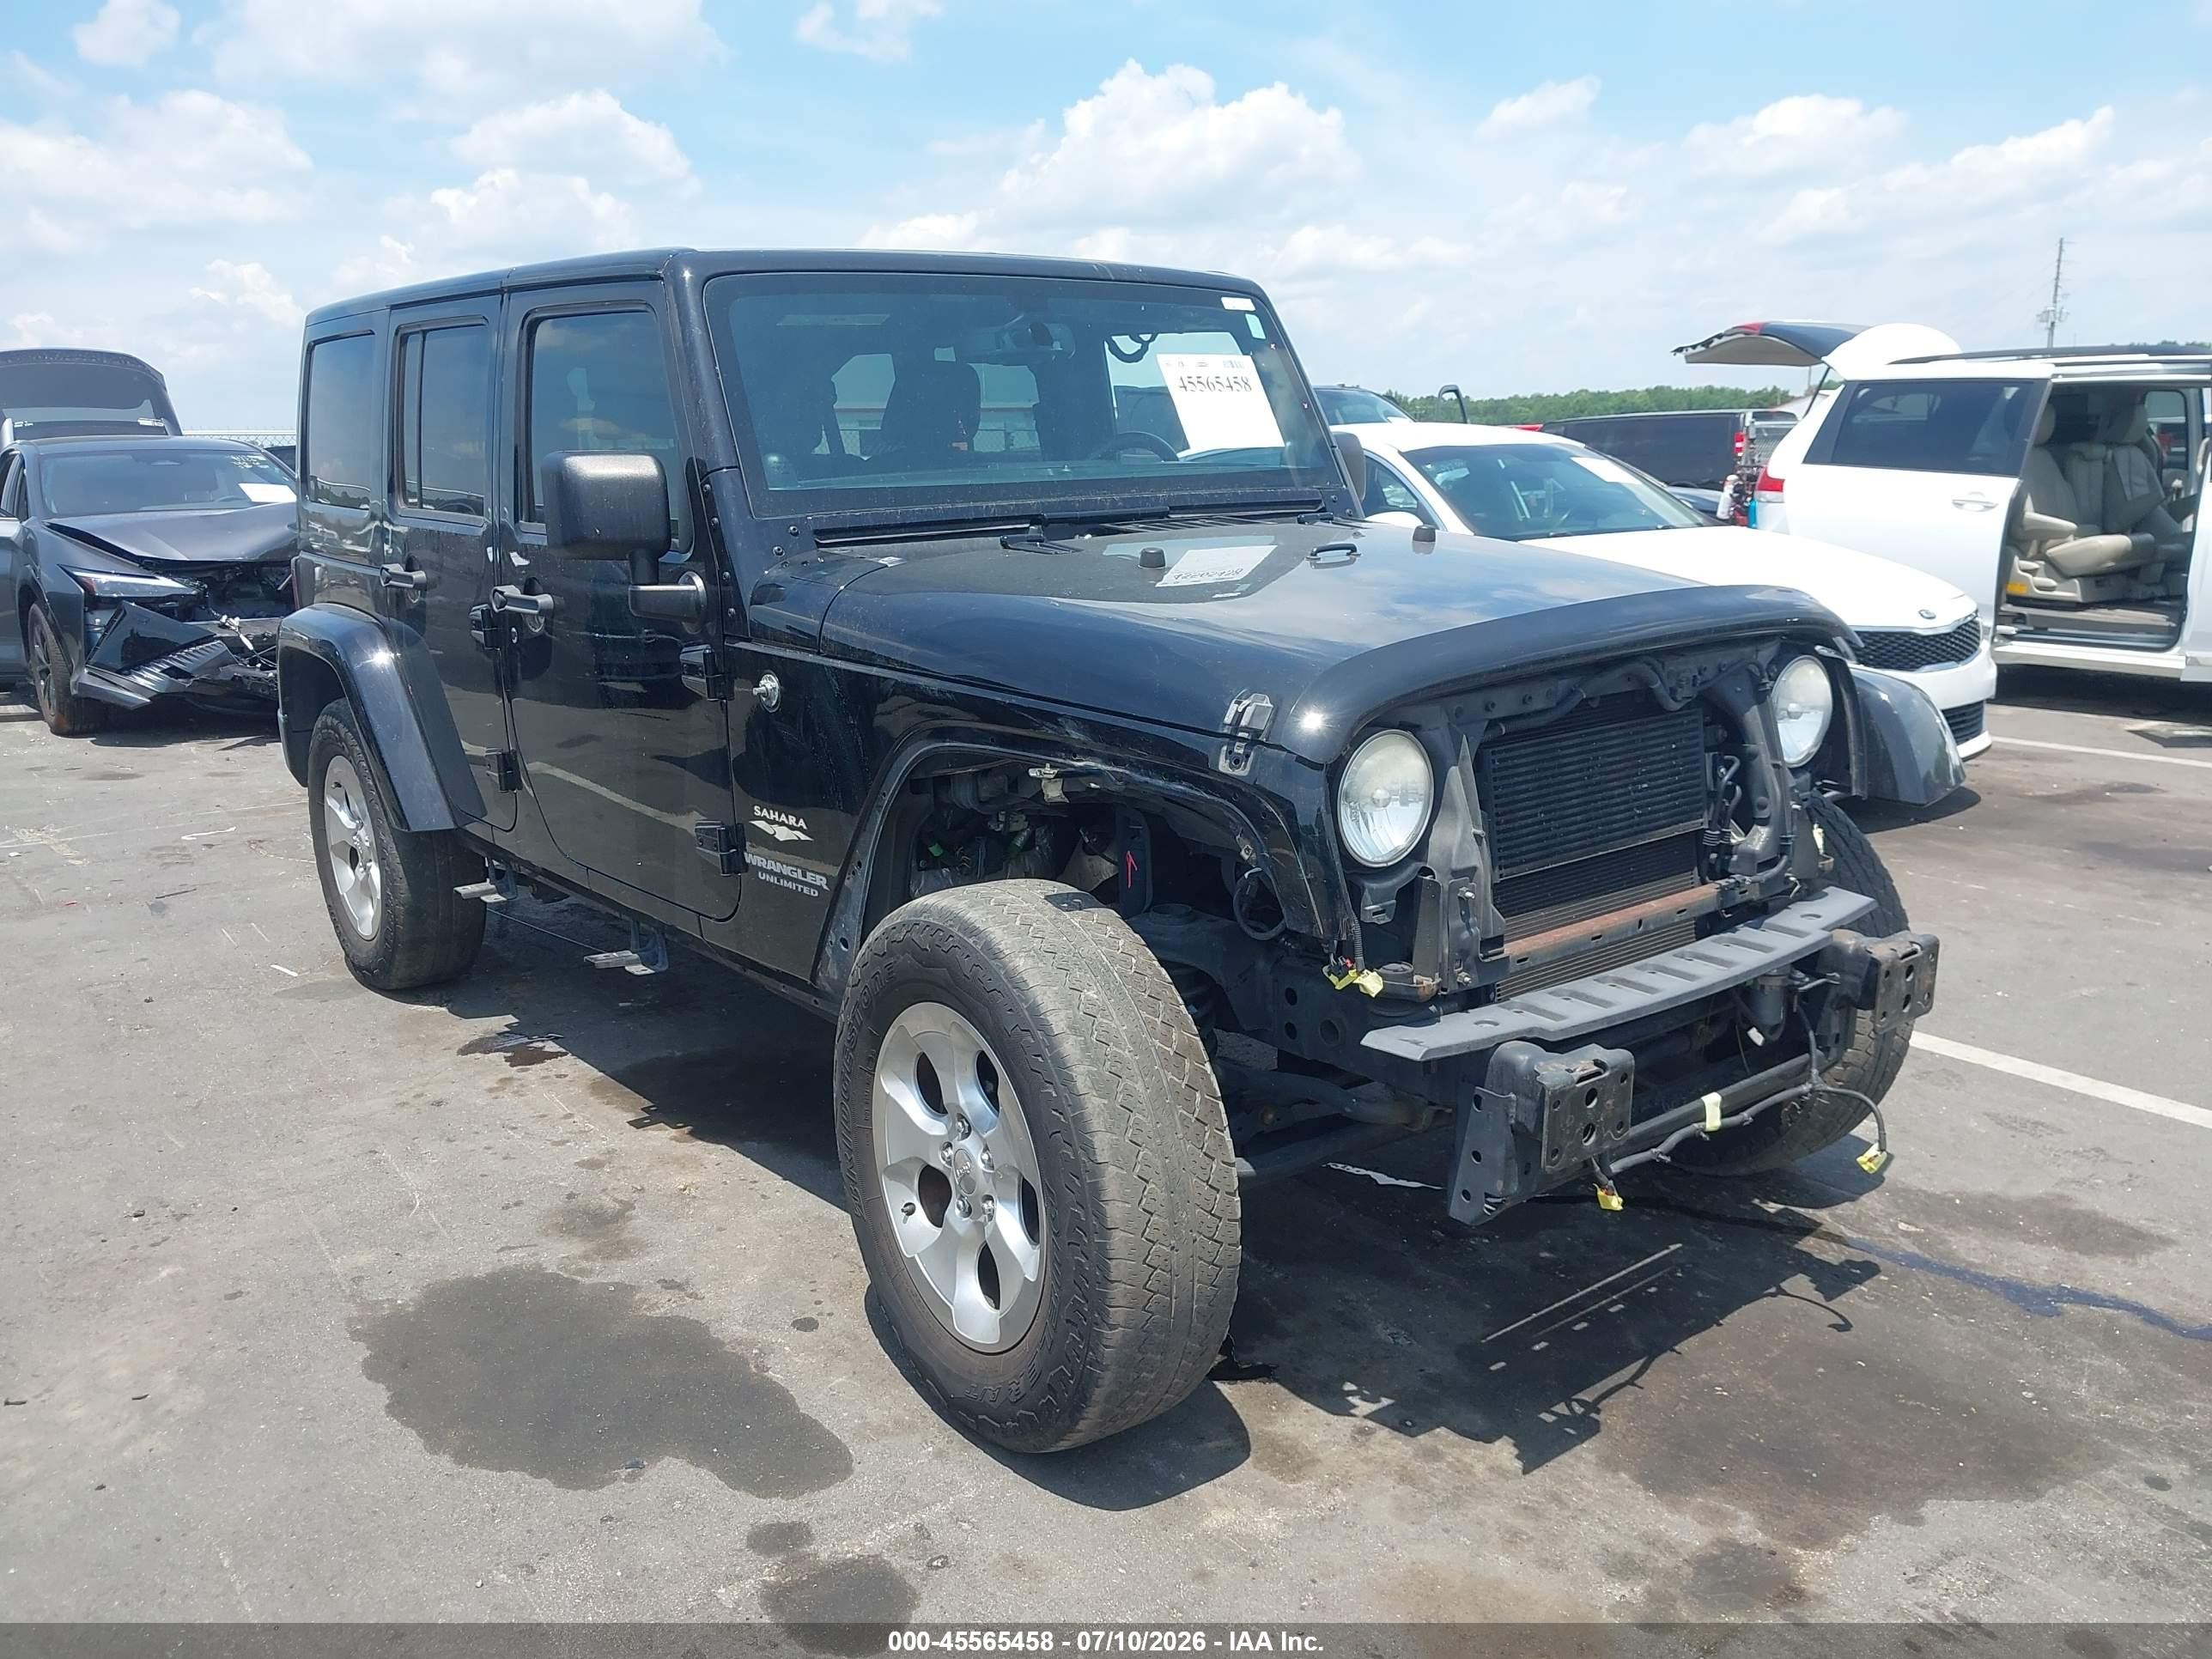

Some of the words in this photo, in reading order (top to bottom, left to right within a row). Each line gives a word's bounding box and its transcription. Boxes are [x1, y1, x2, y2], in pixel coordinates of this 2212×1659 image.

[1178, 375, 1253, 392] 45565458
[753, 805, 808, 830] SAHARA
[744, 852, 830, 891] WRANGLER
[757, 872, 819, 896] UNLIMITED
